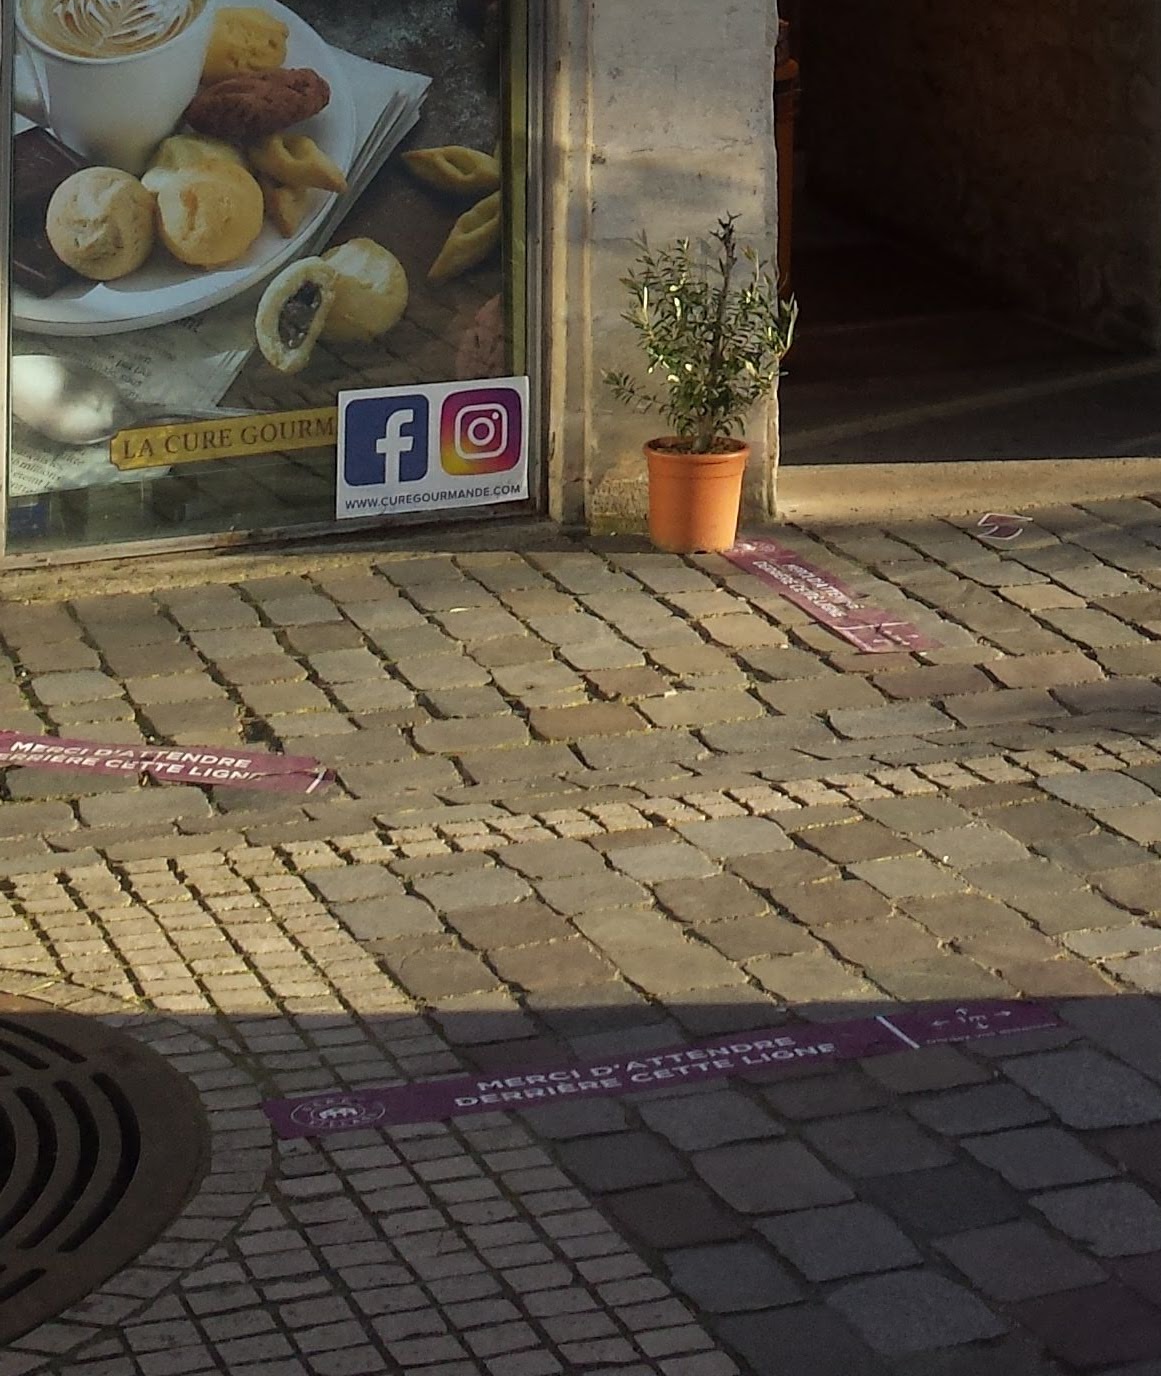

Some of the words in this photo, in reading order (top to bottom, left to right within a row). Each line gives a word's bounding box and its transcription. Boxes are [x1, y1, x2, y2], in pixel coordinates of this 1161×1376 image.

[123, 438, 154, 460] LA
[164, 428, 234, 454] CURE
[345, 484, 521, 510] WWW.CUREGOURMANDE.COM
[10, 741, 89, 756] MERCI
[94, 748, 253, 768] D'ATTENDRE
[105, 759, 186, 774] CETTE
[476, 1069, 581, 1092] MERCI
[591, 1035, 797, 1077] D'ATTENDRE
[631, 1058, 734, 1085] CETTE
[742, 1042, 838, 1066] LIGNE
